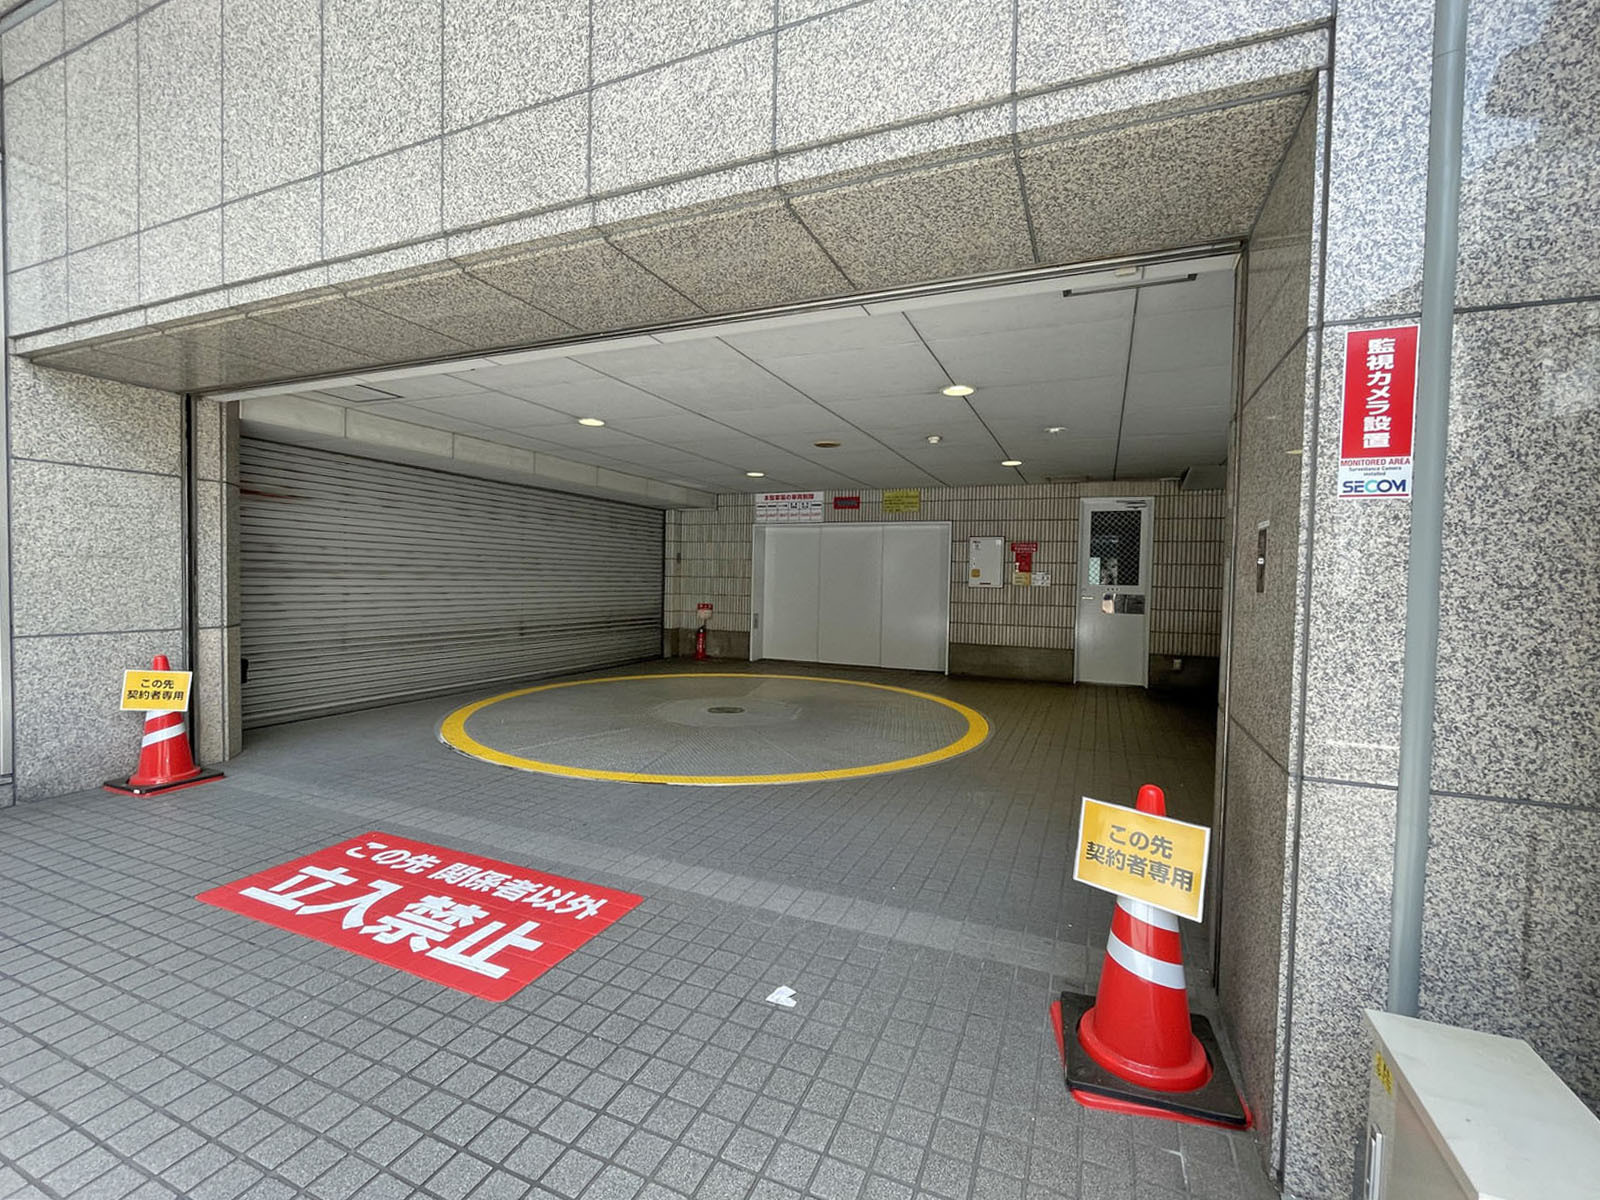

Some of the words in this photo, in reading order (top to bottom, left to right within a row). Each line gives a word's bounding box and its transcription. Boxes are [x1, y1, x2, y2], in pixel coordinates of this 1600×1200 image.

[1363, 338, 1395, 448] 監視カメラ設置
[1340, 459, 1387, 467] MONITORED
[1388, 457, 1411, 465] AREA
[1343, 479, 1406, 493] SECOM
[127, 690, 184, 701] 契約者専用
[140, 679, 174, 689] この先
[1109, 825, 1173, 859] この先
[345, 841, 438, 875] この先
[427, 863, 608, 919] 関係者以外
[1086, 841, 1193, 892] 契約者専用
[239, 865, 544, 979] 立入禁止
